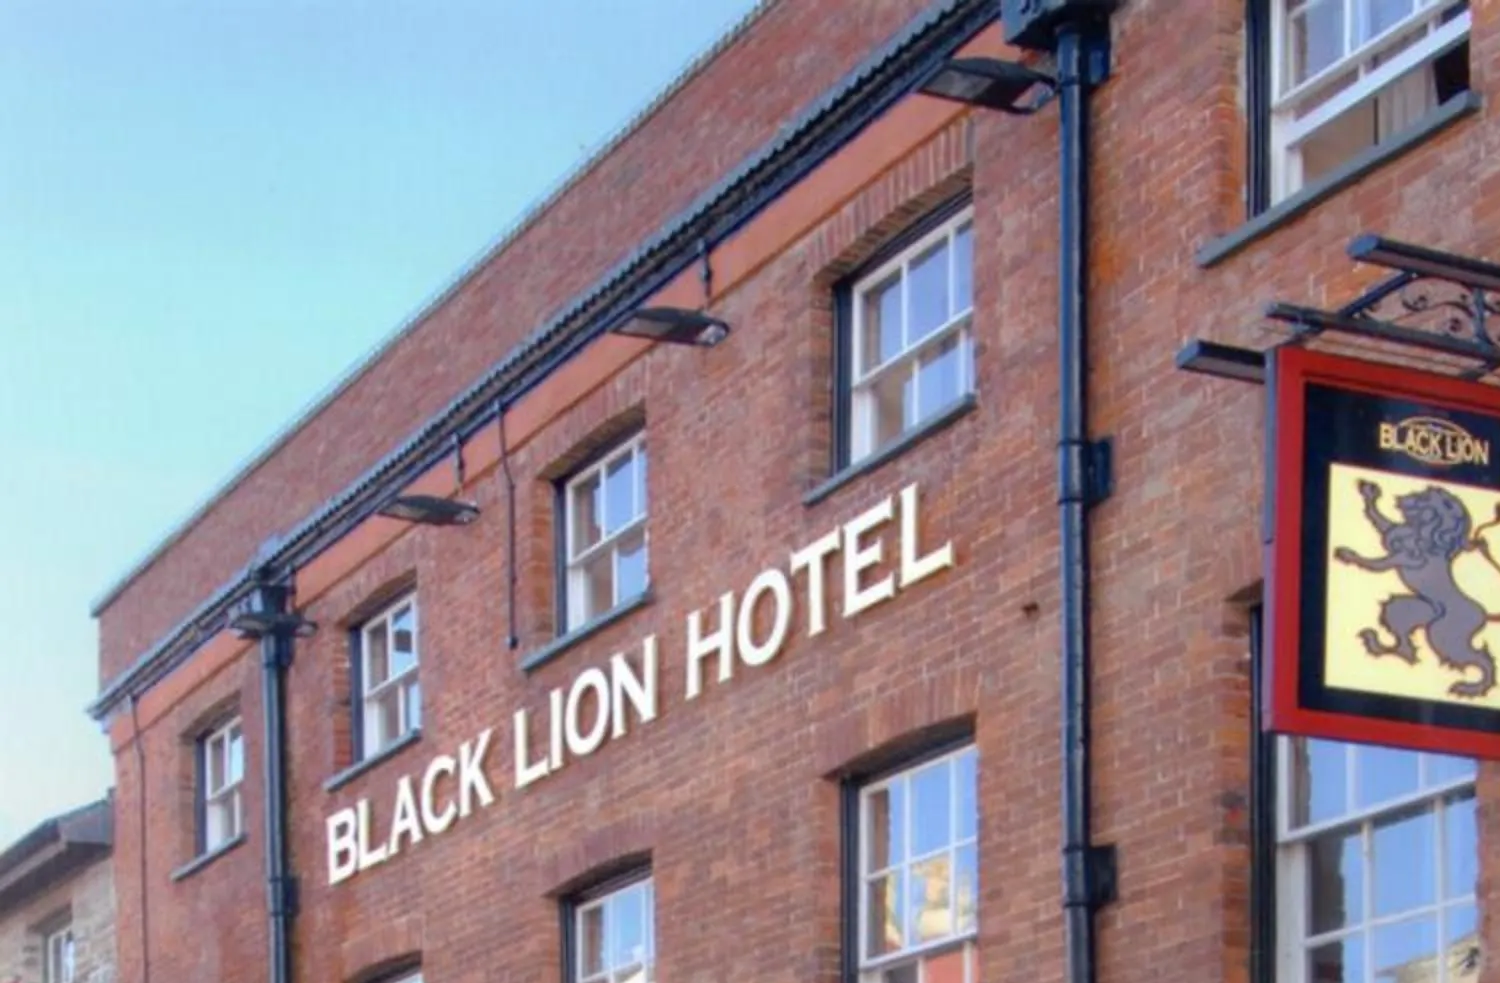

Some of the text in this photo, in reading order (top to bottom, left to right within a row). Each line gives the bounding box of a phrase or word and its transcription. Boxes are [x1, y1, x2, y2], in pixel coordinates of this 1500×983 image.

[1380, 422, 1488, 465] BLACK LION
[326, 482, 953, 885] BLACK LION HOTEL
